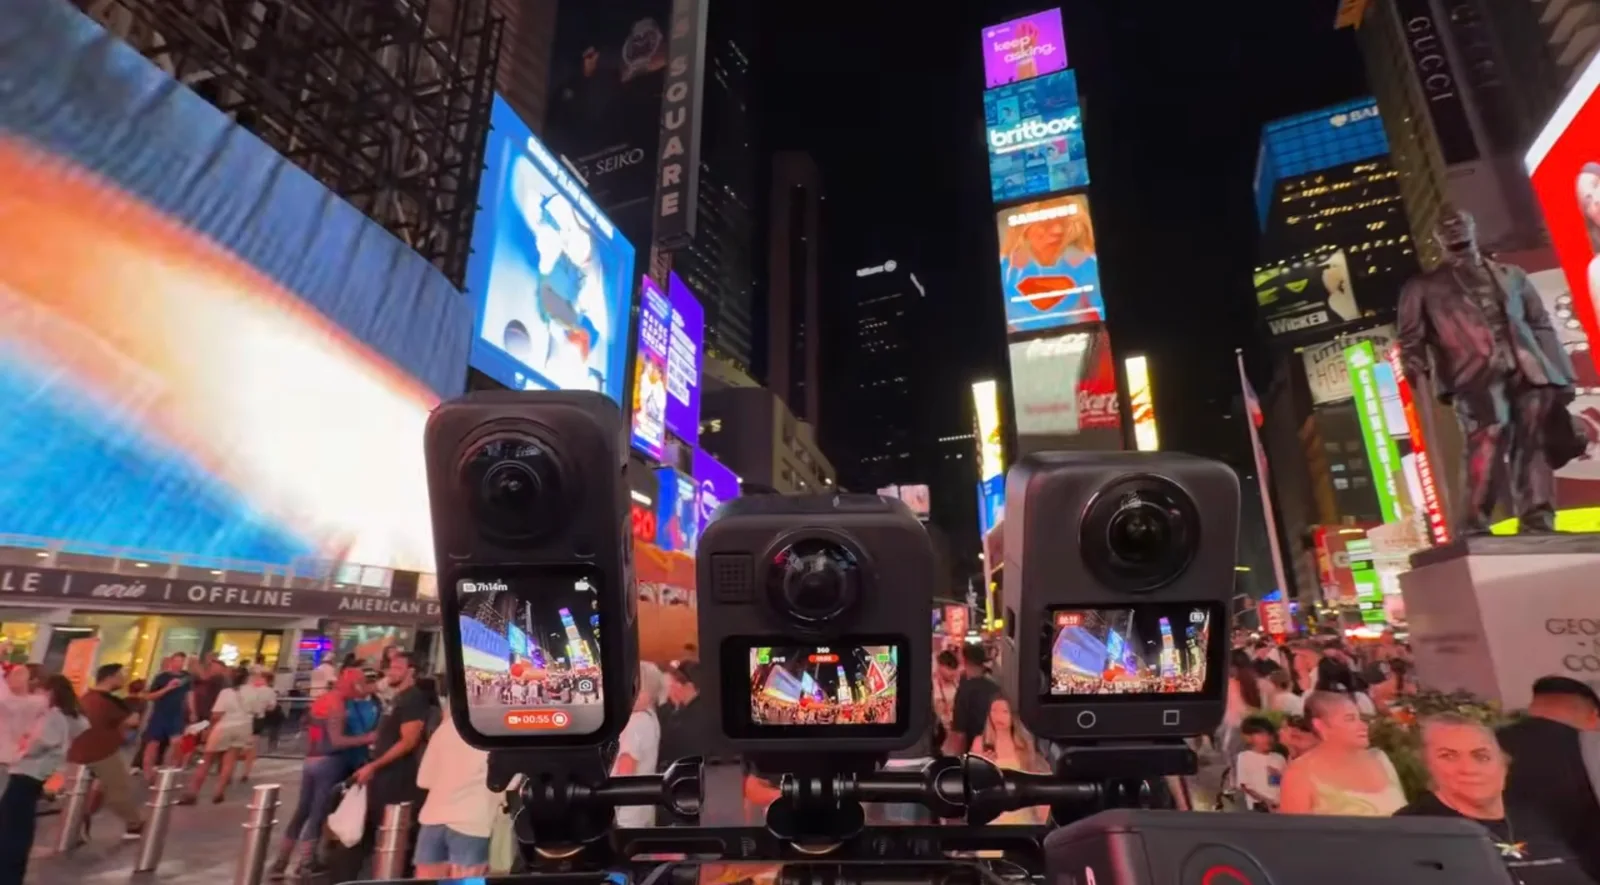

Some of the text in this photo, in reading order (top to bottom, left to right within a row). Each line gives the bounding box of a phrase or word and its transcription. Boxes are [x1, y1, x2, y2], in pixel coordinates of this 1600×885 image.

[993, 35, 1030, 53] keep
[1408, 16, 1453, 101] GUCCI
[661, 56, 689, 217] SQUARE
[990, 115, 1078, 147] britbox
[595, 148, 645, 175] SEIKO
[187, 585, 293, 607] OFFLINE
[477, 582, 508, 593] 7h14m
[338, 597, 421, 615] AMERICAN
[1545, 617, 1600, 636] GEO
[522, 714, 550, 724] 00:55
